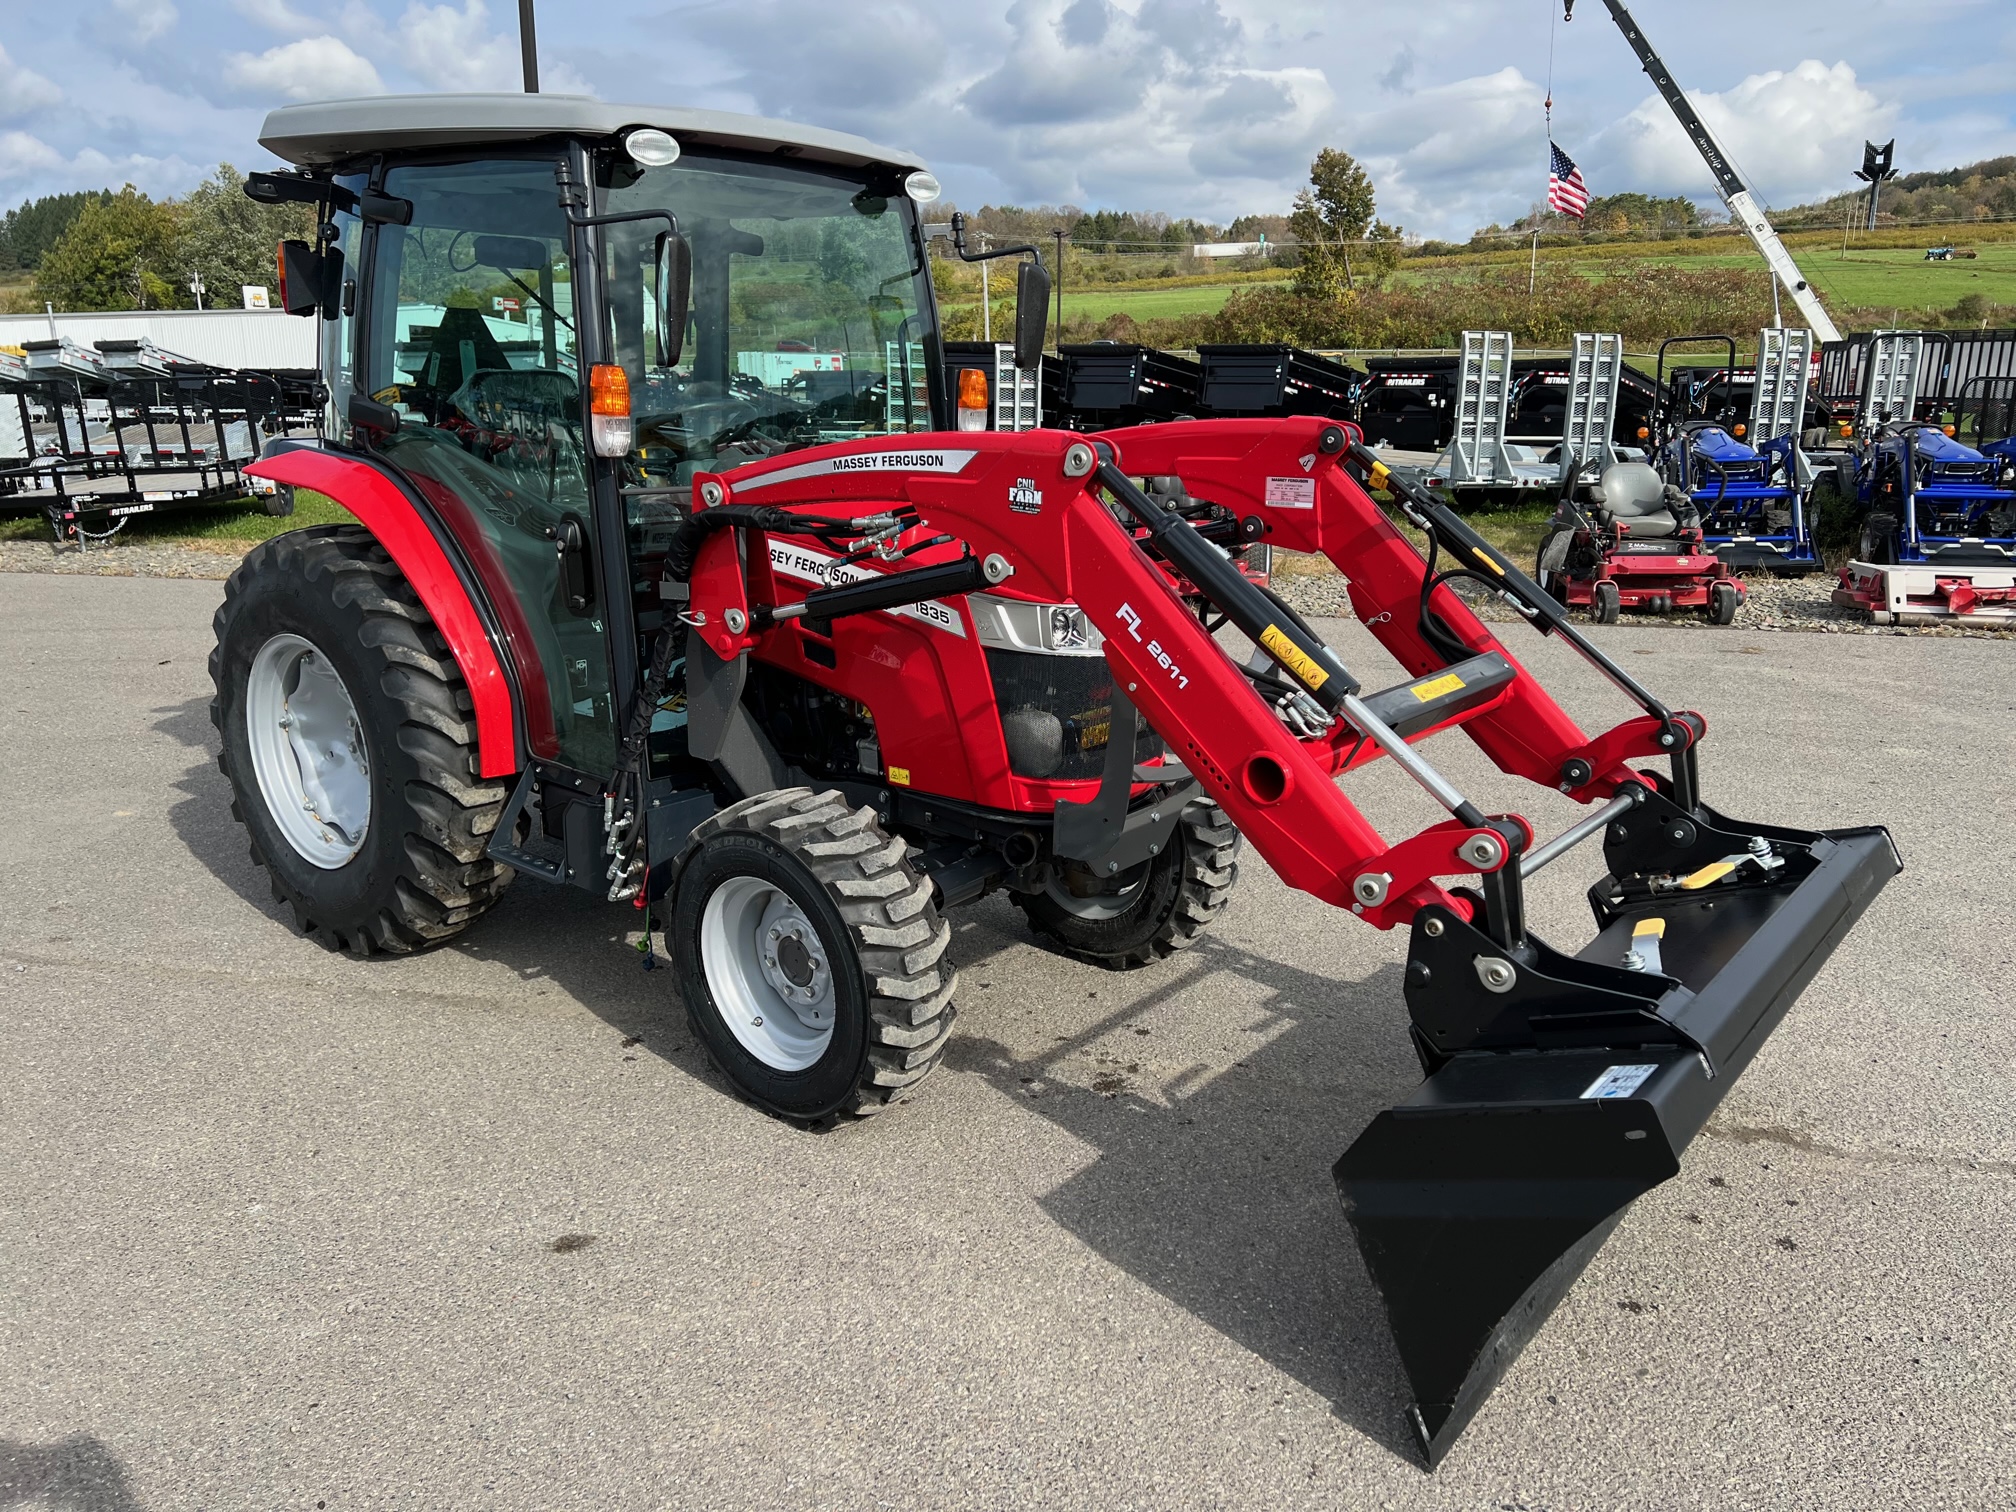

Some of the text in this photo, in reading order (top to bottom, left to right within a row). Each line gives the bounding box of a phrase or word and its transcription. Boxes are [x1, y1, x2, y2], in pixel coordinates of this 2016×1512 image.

[832, 454, 944, 471] MASSEY FERGUSON
[1008, 487, 1042, 505] FARM
[120, 503, 154, 515] TRAILERS
[770, 548, 859, 584] SEY FERGSON
[914, 602, 950, 625] 1835
[1115, 602, 1189, 690] FL 2611
